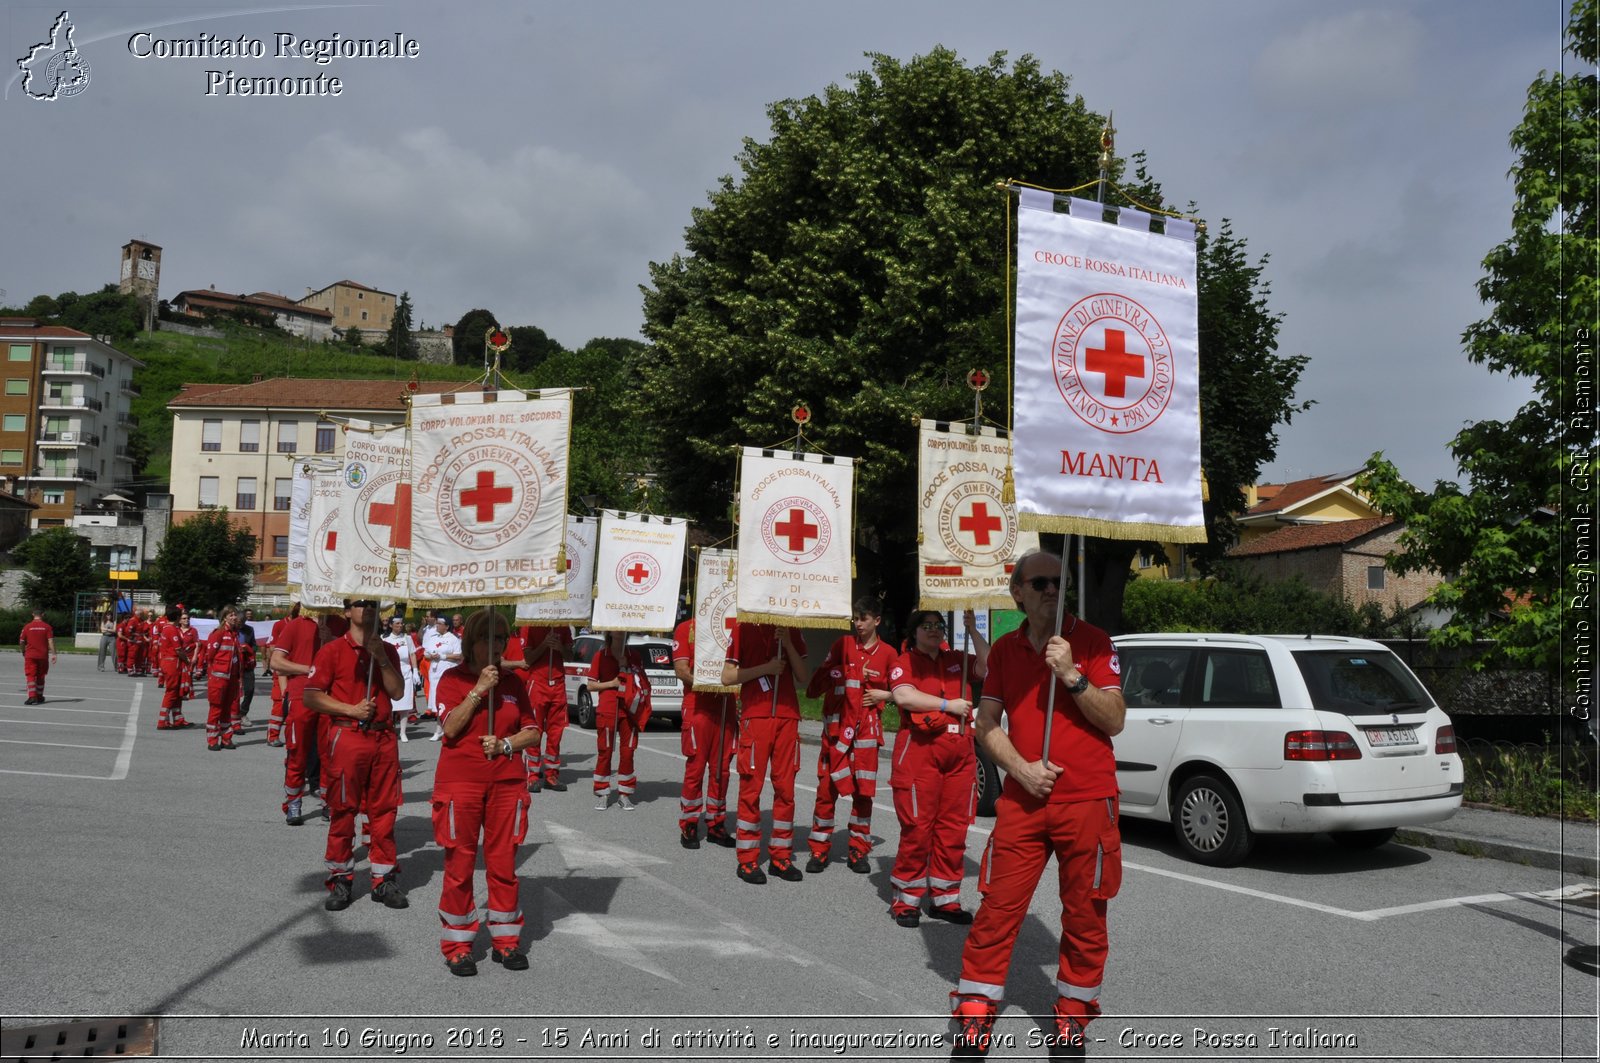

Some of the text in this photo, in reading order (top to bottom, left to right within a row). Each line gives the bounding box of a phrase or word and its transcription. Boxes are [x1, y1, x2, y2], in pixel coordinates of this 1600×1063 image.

[1034, 250, 1187, 289] CROCE ROSSA ITALIANA
[1058, 299, 1170, 428] CONVENZIONE DI GINEVRA 22 AGOSTO 1864
[420, 410, 562, 432] CORPO VOLONTARI DEL SOCCORSO
[351, 440, 376, 452] CORPO
[927, 438, 947, 450] CORPO
[980, 443, 992, 453] DEL
[346, 450, 411, 467] CROCE ROS
[417, 444, 452, 494] CROCE
[450, 426, 507, 450] ROSSA
[510, 430, 561, 485] ITALIANA
[468, 447, 519, 466] GINEVRA
[452, 460, 465, 473] DI
[519, 464, 533, 478] 22
[1059, 449, 1164, 484] MANTA
[751, 467, 841, 509] CROCE ROSSA ITALIANA
[922, 471, 949, 509] CROCE
[948, 461, 989, 476] ROSSA
[963, 484, 1001, 501] GINEVRA
[519, 480, 538, 522] AGOSTO
[952, 489, 963, 501] DI
[298, 502, 311, 520] CRO
[440, 475, 474, 546] CONVENZIONE
[776, 502, 784, 511] DI
[783, 498, 813, 510] GINEVRA
[941, 501, 975, 563] CONVENZIONE
[292, 561, 304, 569] GR
[415, 557, 558, 578] GRUPPO DI MELLE
[415, 575, 557, 594] COMITATO LOCALE
[751, 569, 839, 584] COMITATO LOCALE
[925, 576, 1010, 588] COMITATO DI MO
[305, 583, 332, 592] COMITA
[790, 584, 801, 594] DI
[606, 602, 655, 612] DELEGAZIONE
[698, 580, 736, 617] CROCE RO
[768, 596, 822, 609] BUSCA
[696, 669, 721, 677] BORG
